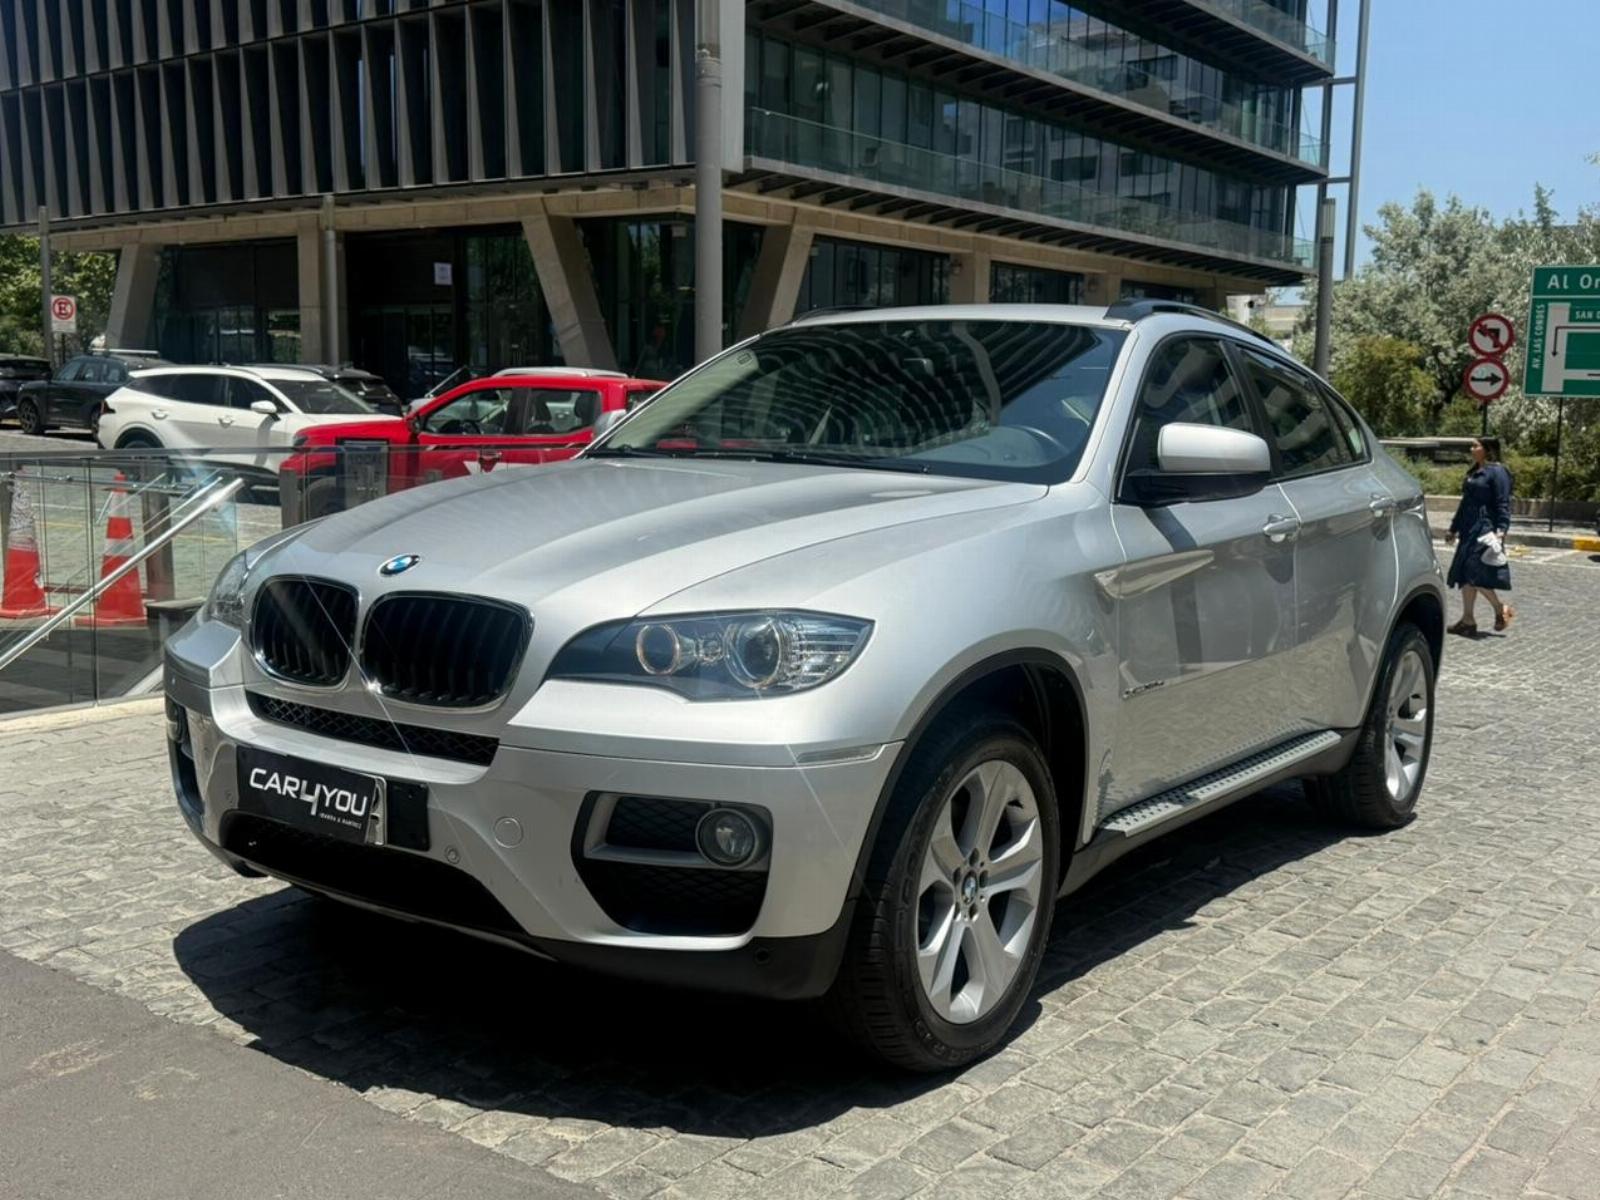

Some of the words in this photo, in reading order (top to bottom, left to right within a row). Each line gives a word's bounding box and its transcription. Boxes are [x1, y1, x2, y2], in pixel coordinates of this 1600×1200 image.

[1547, 274, 1569, 289] Al
[1534, 304, 1546, 336] CONDES
[1575, 310, 1593, 320] SAN
[1532, 338, 1543, 353] LAS
[250, 767, 368, 816] CAR4YOU
